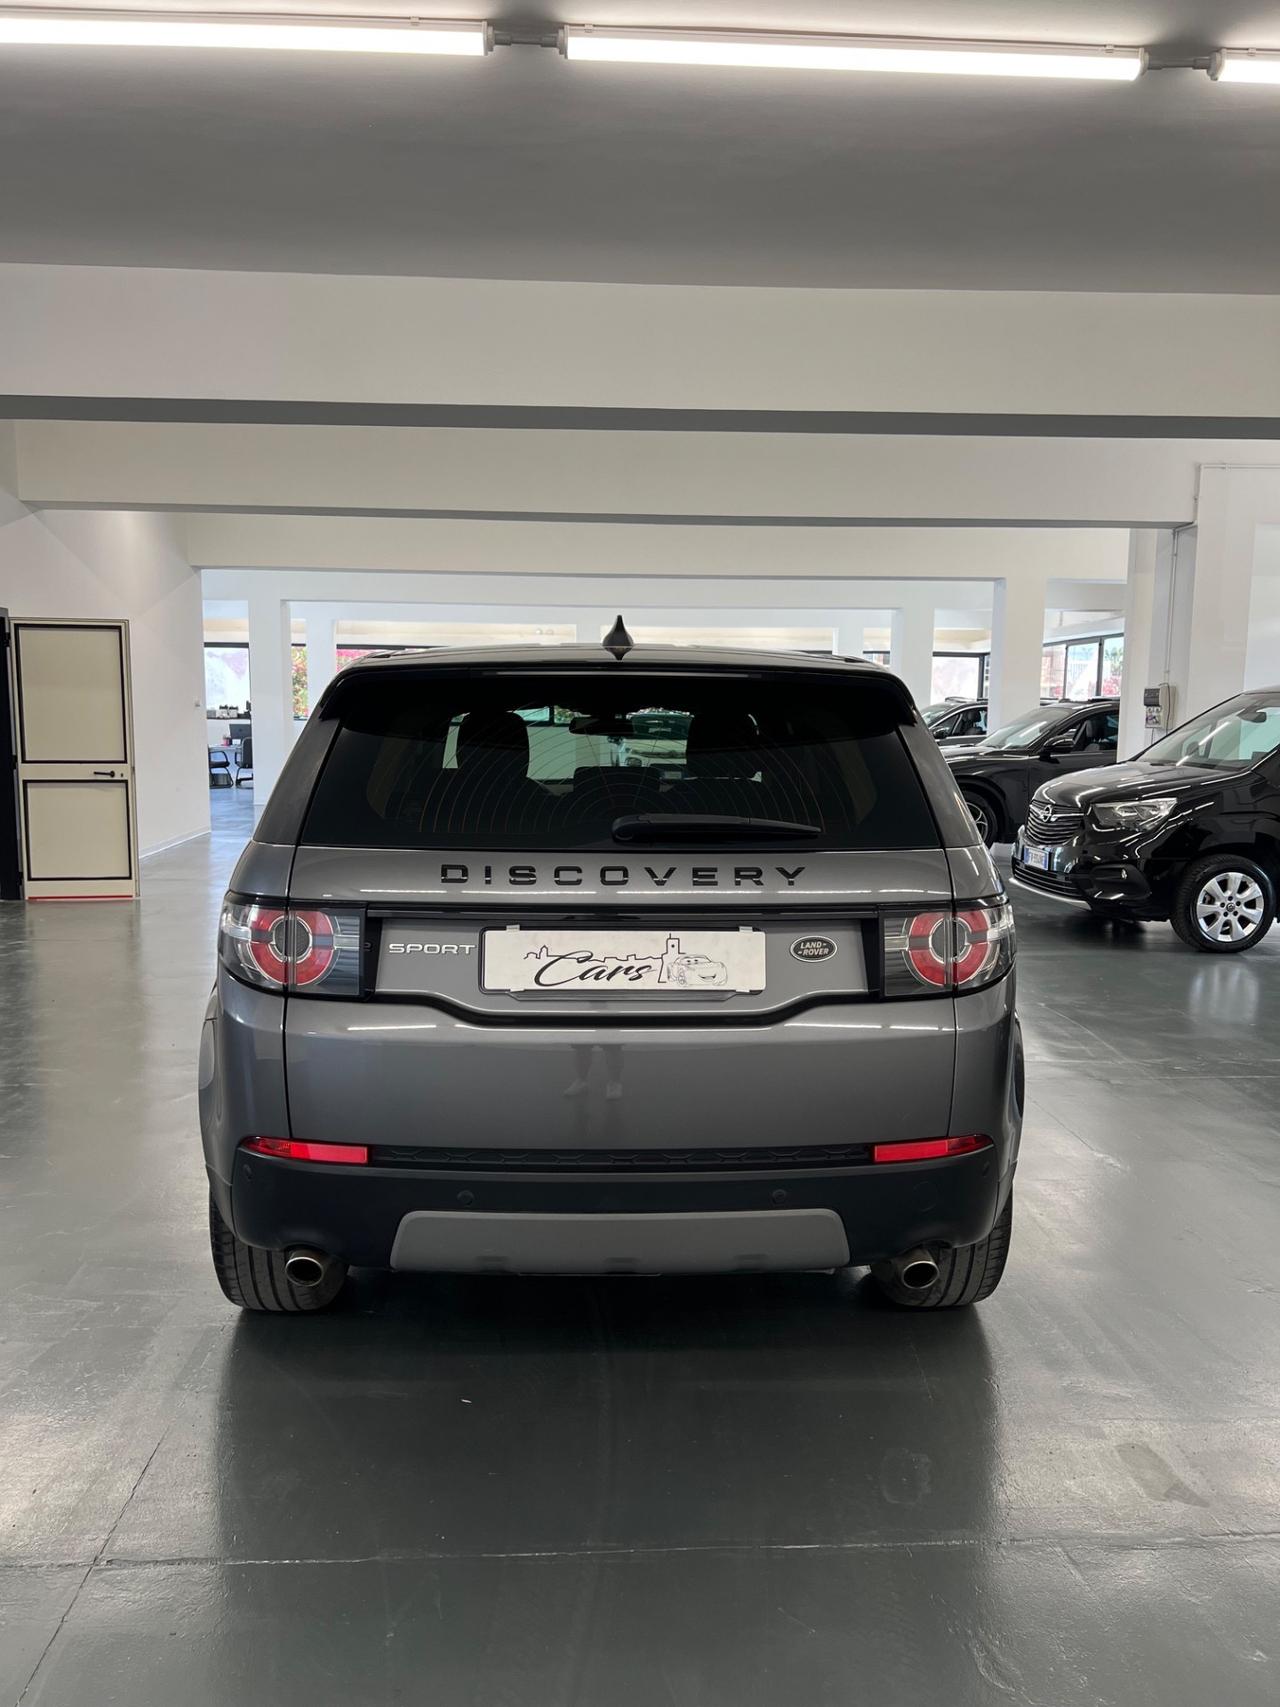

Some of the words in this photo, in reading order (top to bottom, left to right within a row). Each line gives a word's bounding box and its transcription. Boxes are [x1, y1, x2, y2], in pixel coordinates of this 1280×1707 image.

[440, 863, 806, 887] DISCOVERY
[388, 943, 476, 955] SPORT
[534, 950, 657, 987] Cars
